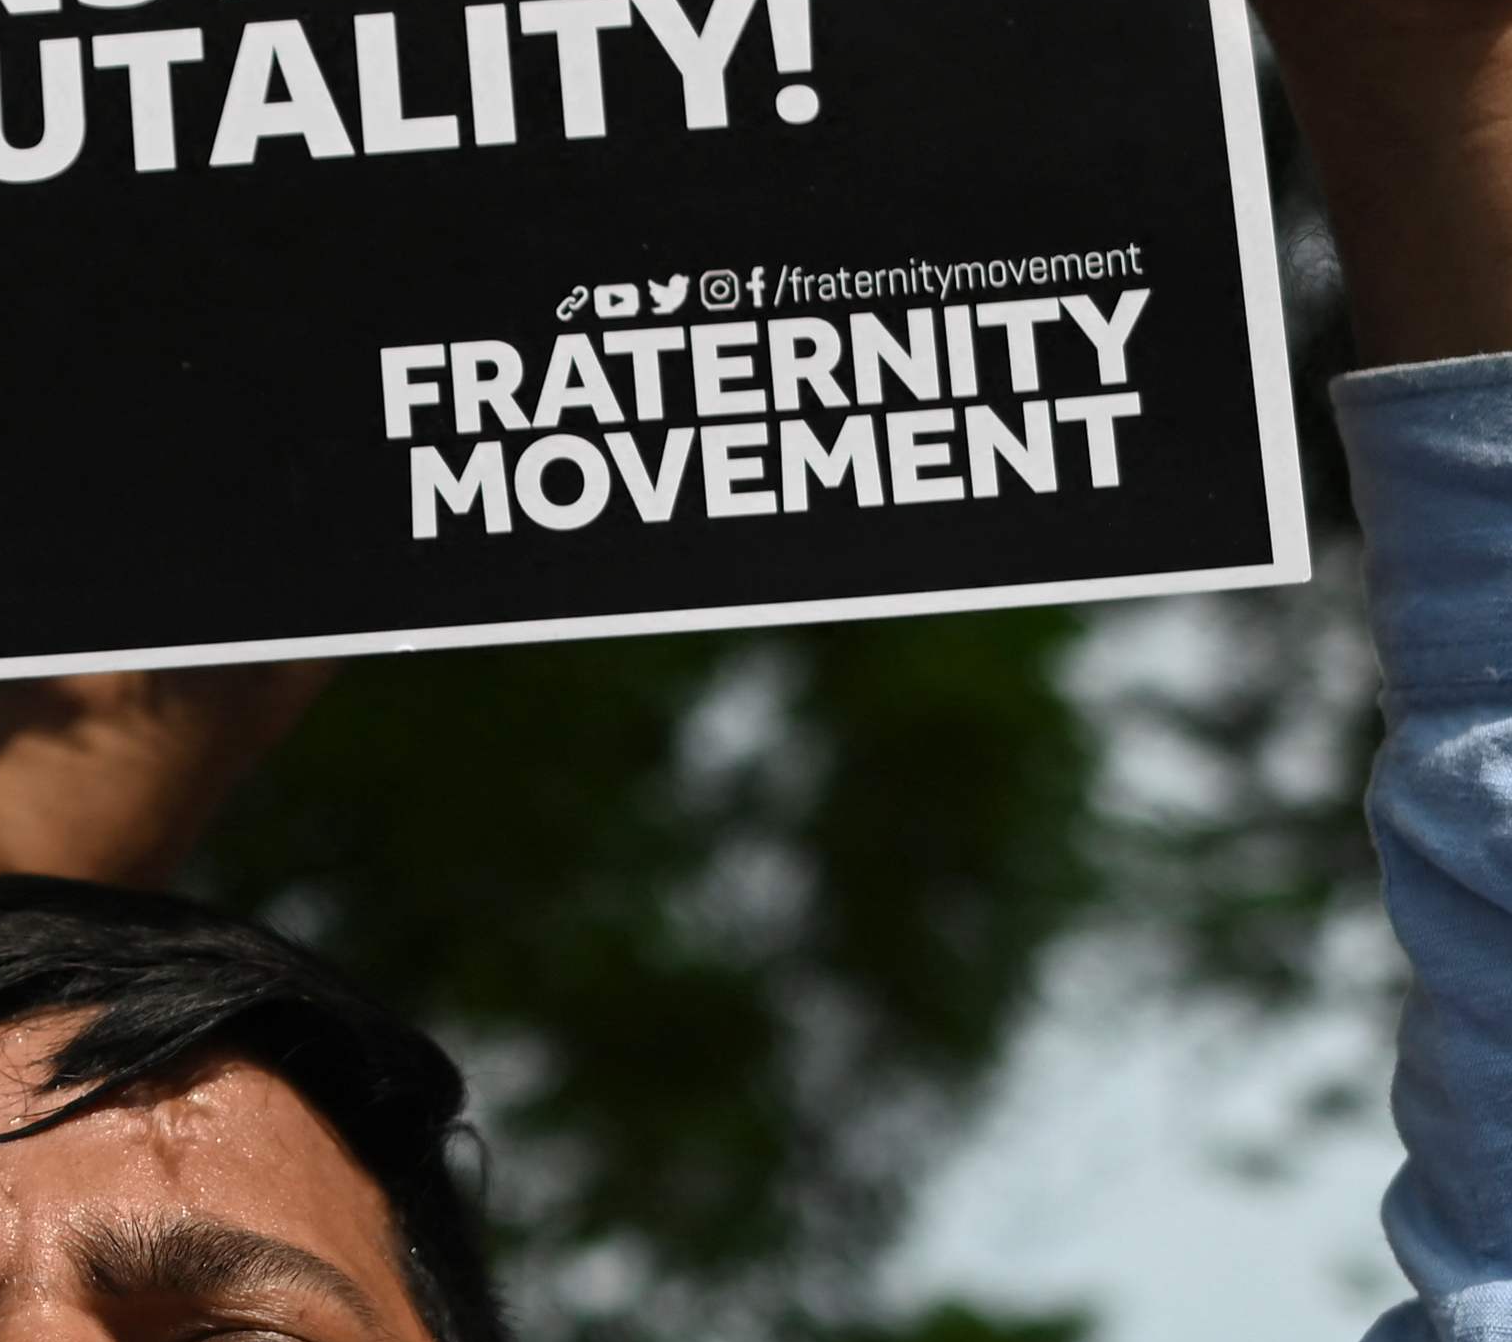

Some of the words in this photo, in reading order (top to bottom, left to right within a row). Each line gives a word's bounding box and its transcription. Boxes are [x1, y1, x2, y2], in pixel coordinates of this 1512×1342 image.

[774, 242, 1144, 307] /fraternitymovement
[380, 289, 1151, 440] FRATERNITY
[409, 391, 1142, 540] MOVEMENT
